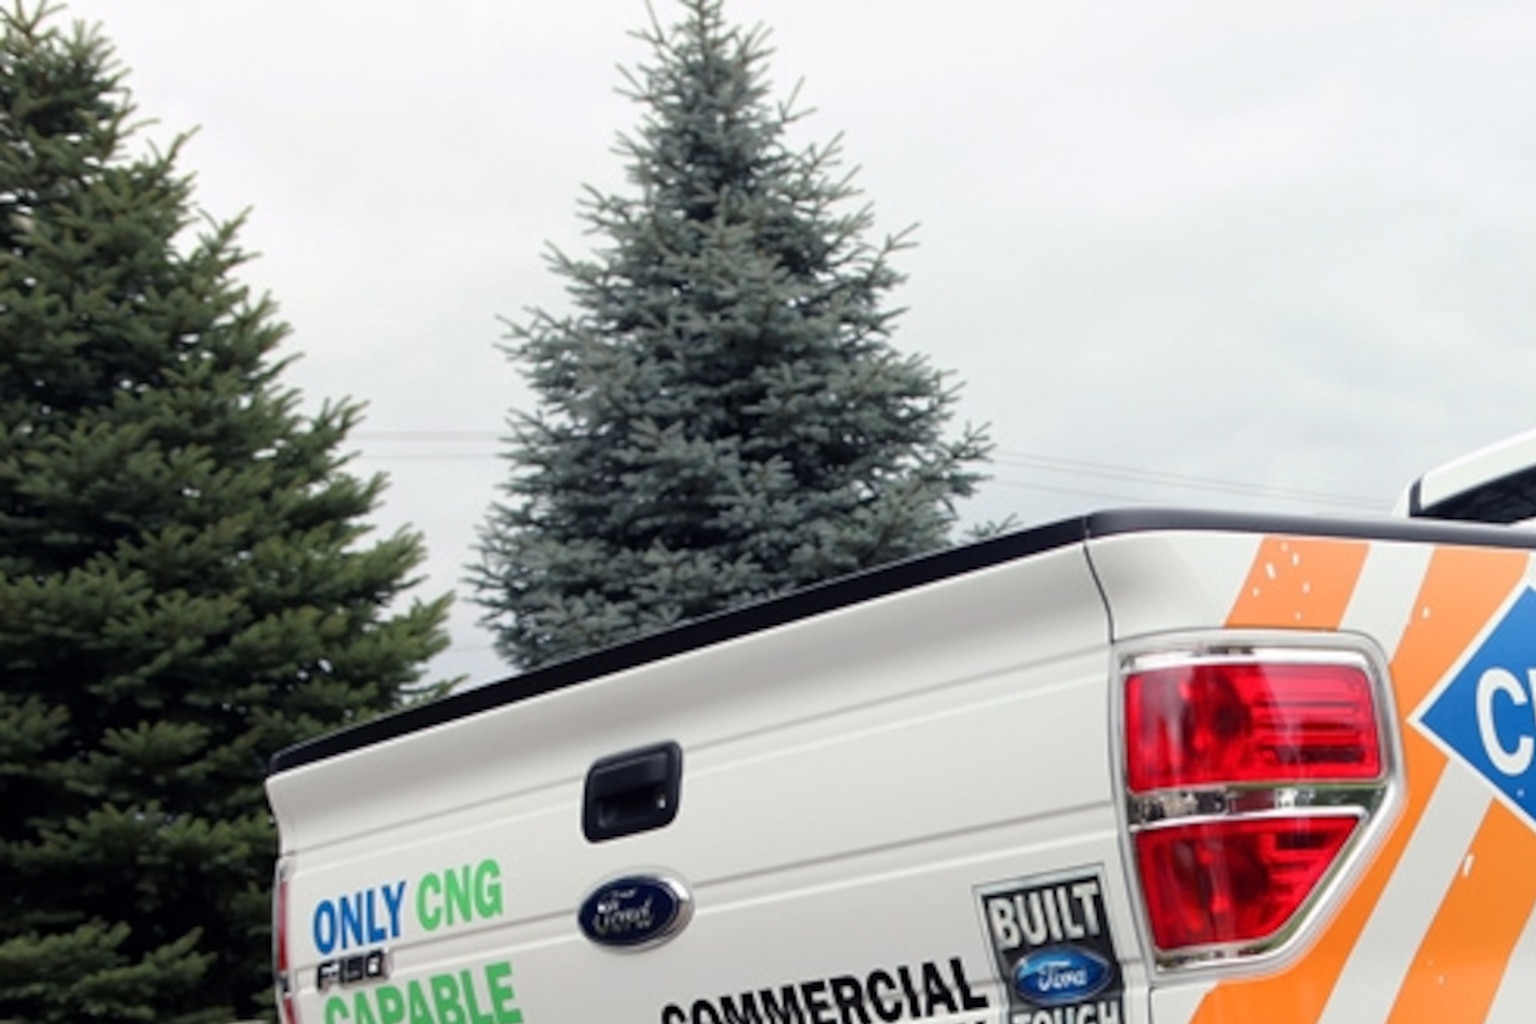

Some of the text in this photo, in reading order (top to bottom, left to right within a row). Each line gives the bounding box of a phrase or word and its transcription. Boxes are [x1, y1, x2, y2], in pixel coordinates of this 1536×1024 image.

[313, 859, 504, 955] ONLY CNG
[987, 881, 1101, 948] BUILT
[1037, 959, 1088, 992] Ford
